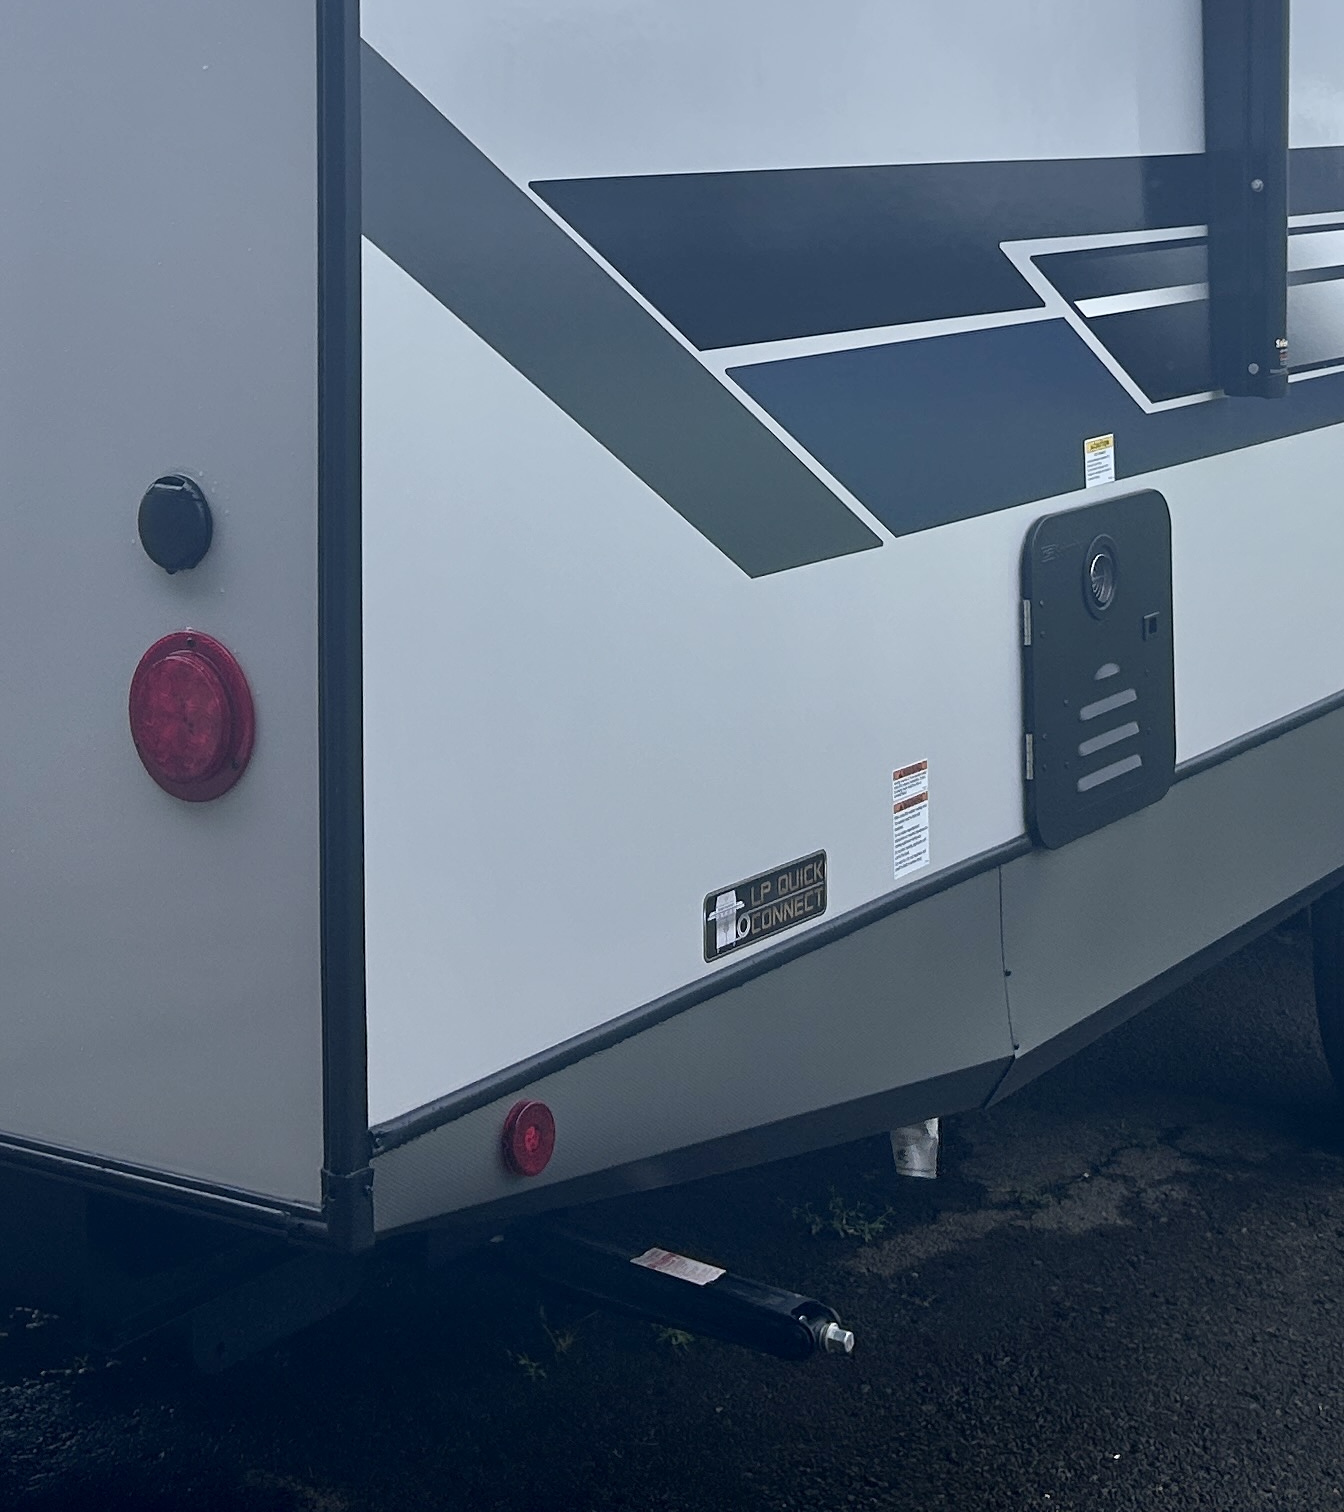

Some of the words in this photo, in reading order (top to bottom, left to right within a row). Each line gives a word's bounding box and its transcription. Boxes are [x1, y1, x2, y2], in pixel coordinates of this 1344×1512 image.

[750, 881, 772, 907] LP
[777, 860, 824, 896] QUICK
[751, 887, 824, 935] CONNECT
